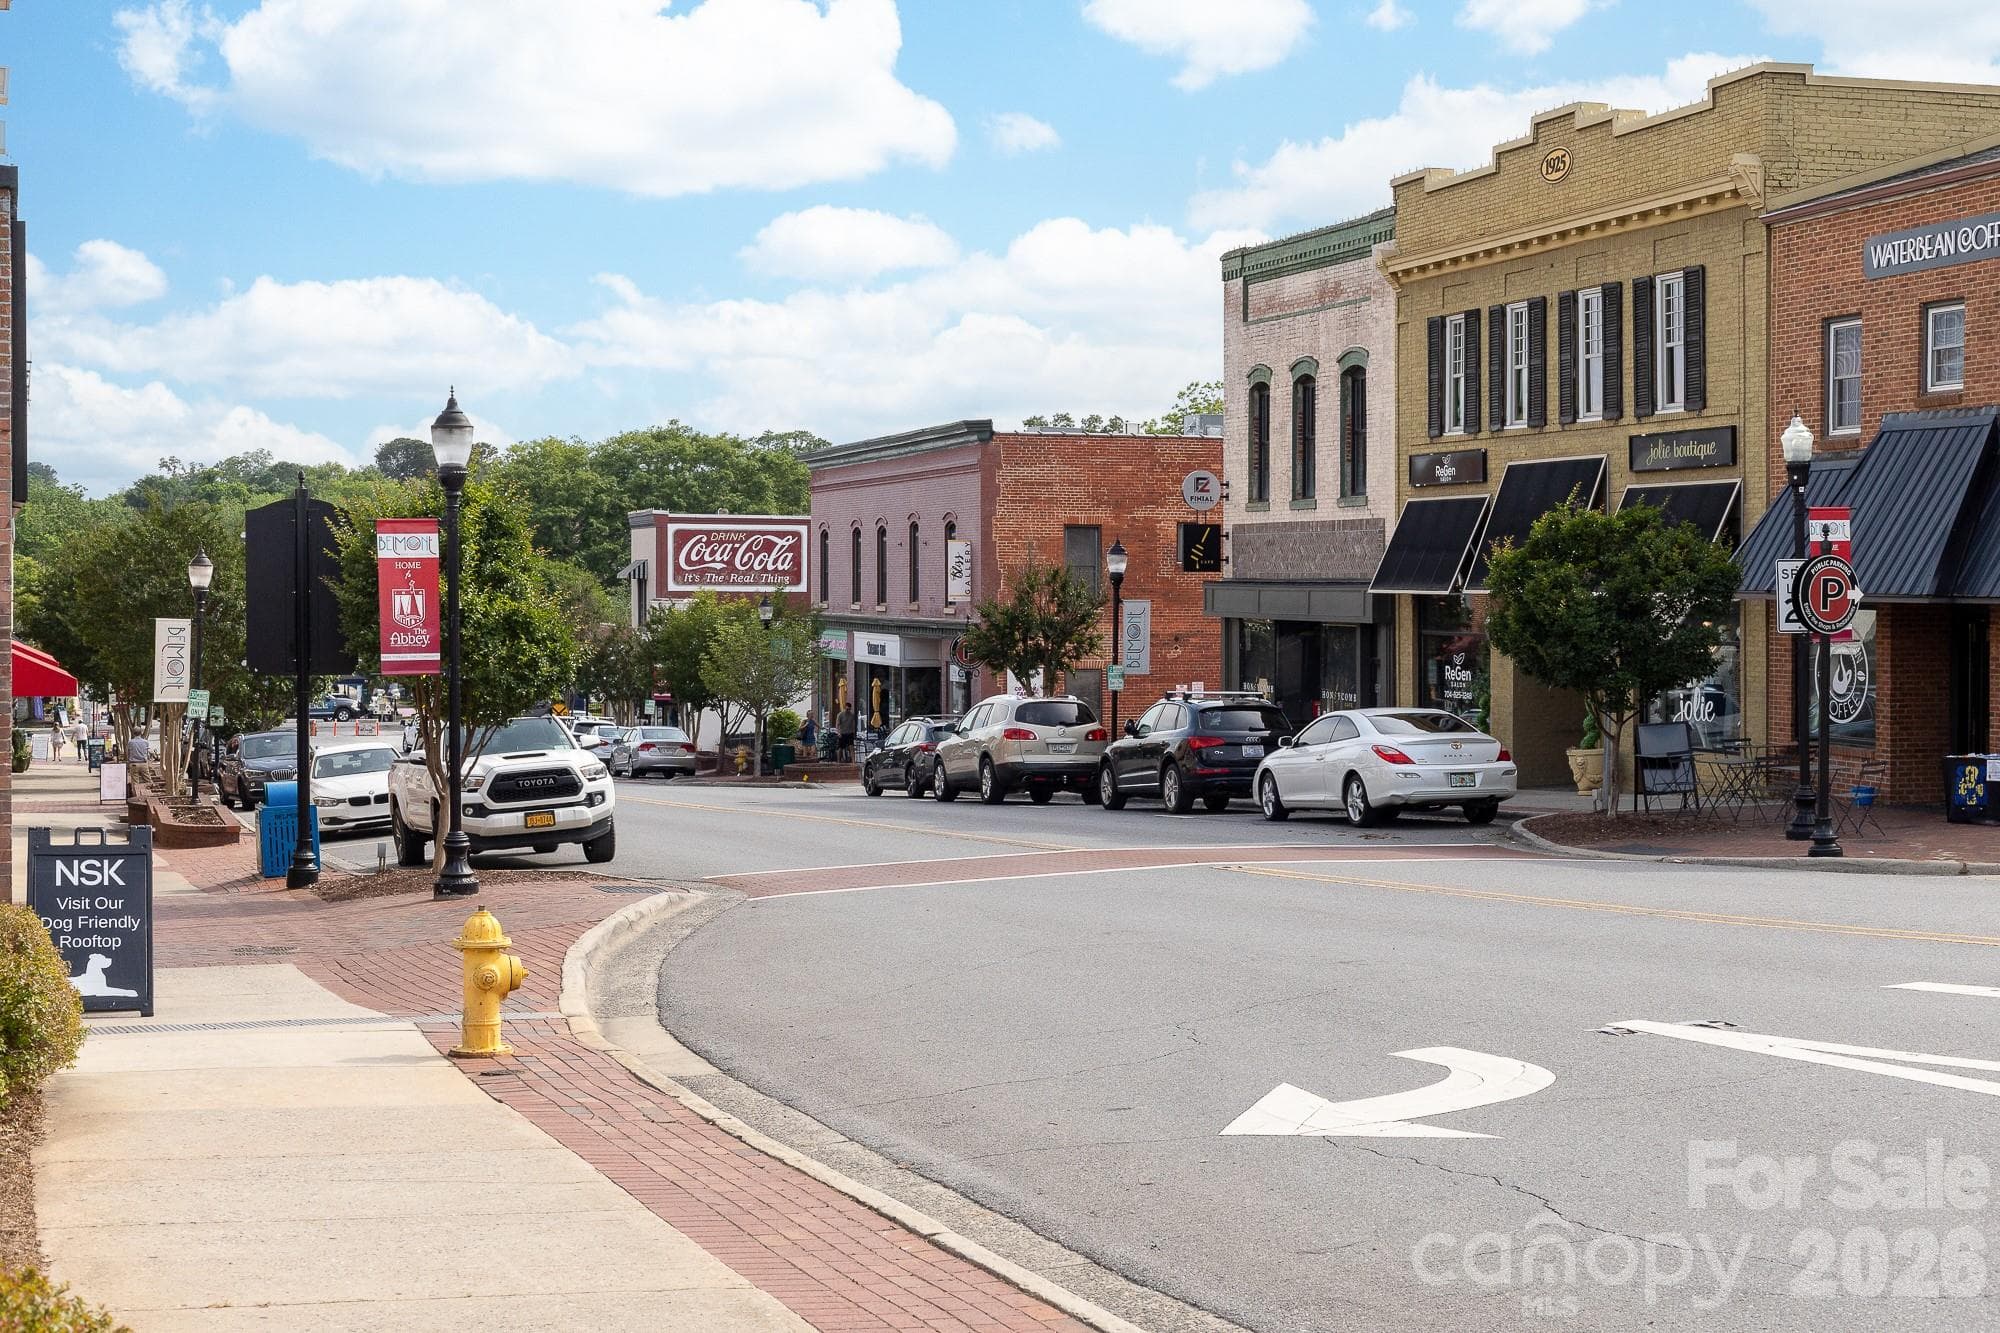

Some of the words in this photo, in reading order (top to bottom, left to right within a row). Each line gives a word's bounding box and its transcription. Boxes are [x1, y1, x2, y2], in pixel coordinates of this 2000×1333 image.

[1545, 153, 1566, 175] 1925
[1871, 230, 1956, 269] WATERBEAN
[1646, 439, 1671, 465] jolie
[1673, 440, 1717, 460] boutique
[1435, 465, 1456, 477] ReGen
[711, 533, 746, 541] DRINK
[679, 534, 798, 571] Coca-Cola
[951, 552, 963, 580] Bliss
[1811, 560, 1830, 575] PUBLIC
[1830, 560, 1852, 576] PARKING
[684, 573, 700, 582] It's
[705, 573, 724, 582] The
[730, 573, 754, 583] Real
[761, 573, 790, 584] Thing
[1821, 577, 1845, 611] P
[1445, 665, 1472, 681] ReGen
[1672, 687, 1715, 722] jolie
[1829, 693, 1860, 719] OFFEE
[519, 778, 554, 788] TOYOTA
[55, 859, 126, 887] NSK
[56, 897, 91, 910] Visit
[95, 897, 124, 910] Our
[41, 917, 72, 932] Dog
[78, 915, 141, 931] Friendly
[60, 935, 122, 950] Rooftop
